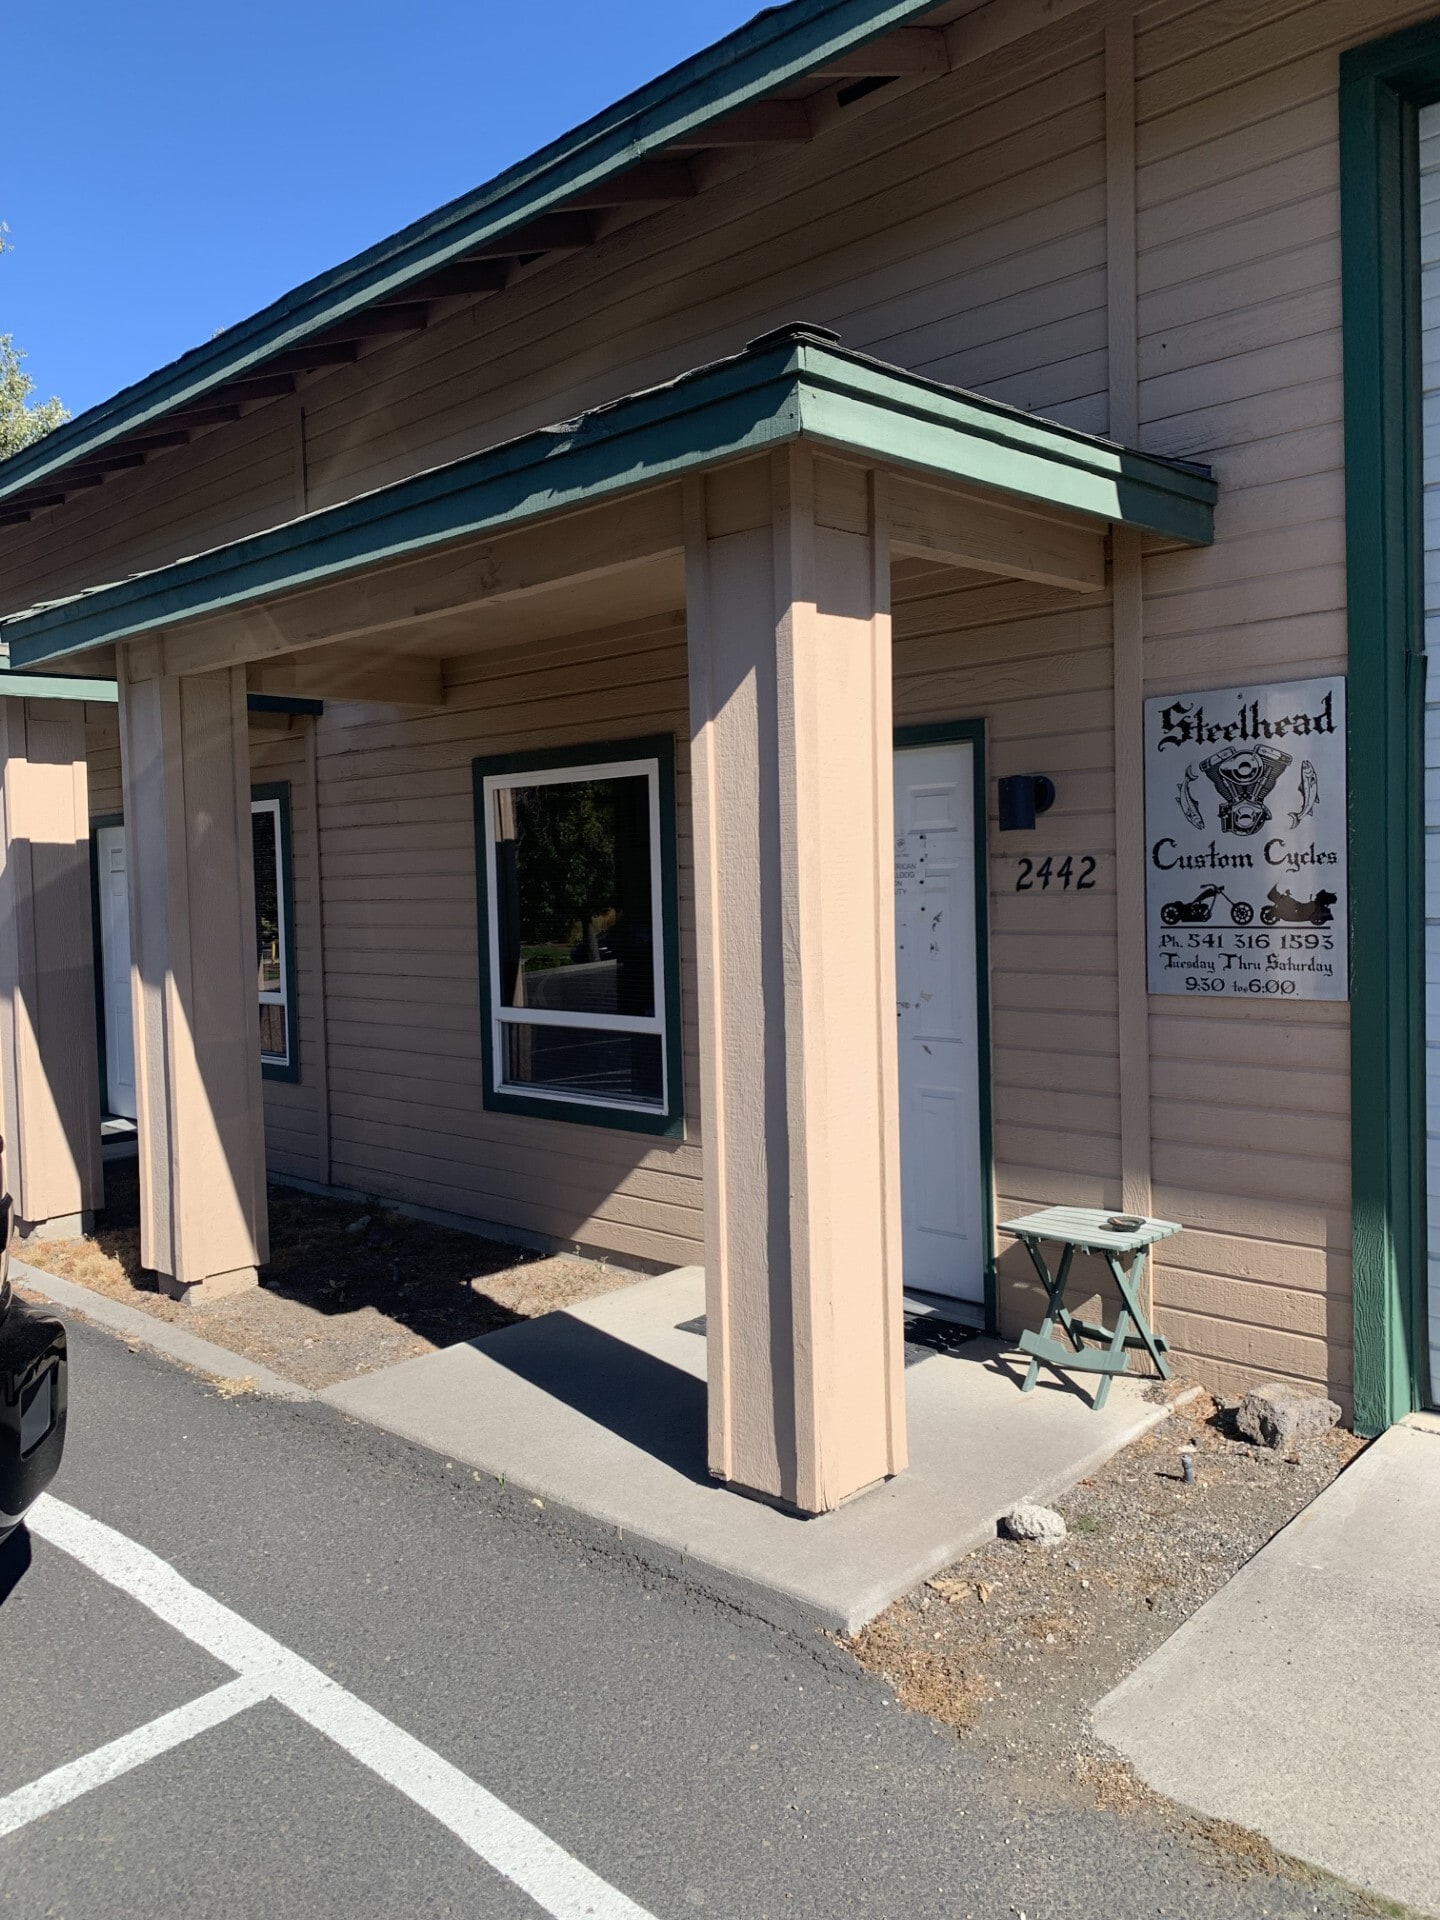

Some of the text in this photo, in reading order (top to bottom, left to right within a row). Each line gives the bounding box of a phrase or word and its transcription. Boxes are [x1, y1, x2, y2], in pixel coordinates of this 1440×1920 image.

[1157, 690, 1337, 752] Steelhead
[1152, 838, 1338, 873] Custom Cycles
[1016, 855, 1096, 892] 2442
[1158, 933, 1334, 950] Ph. 541 316 1593
[1159, 952, 1334, 977] Tuesday Thru Saturday
[1185, 976, 1226, 992] 9:30
